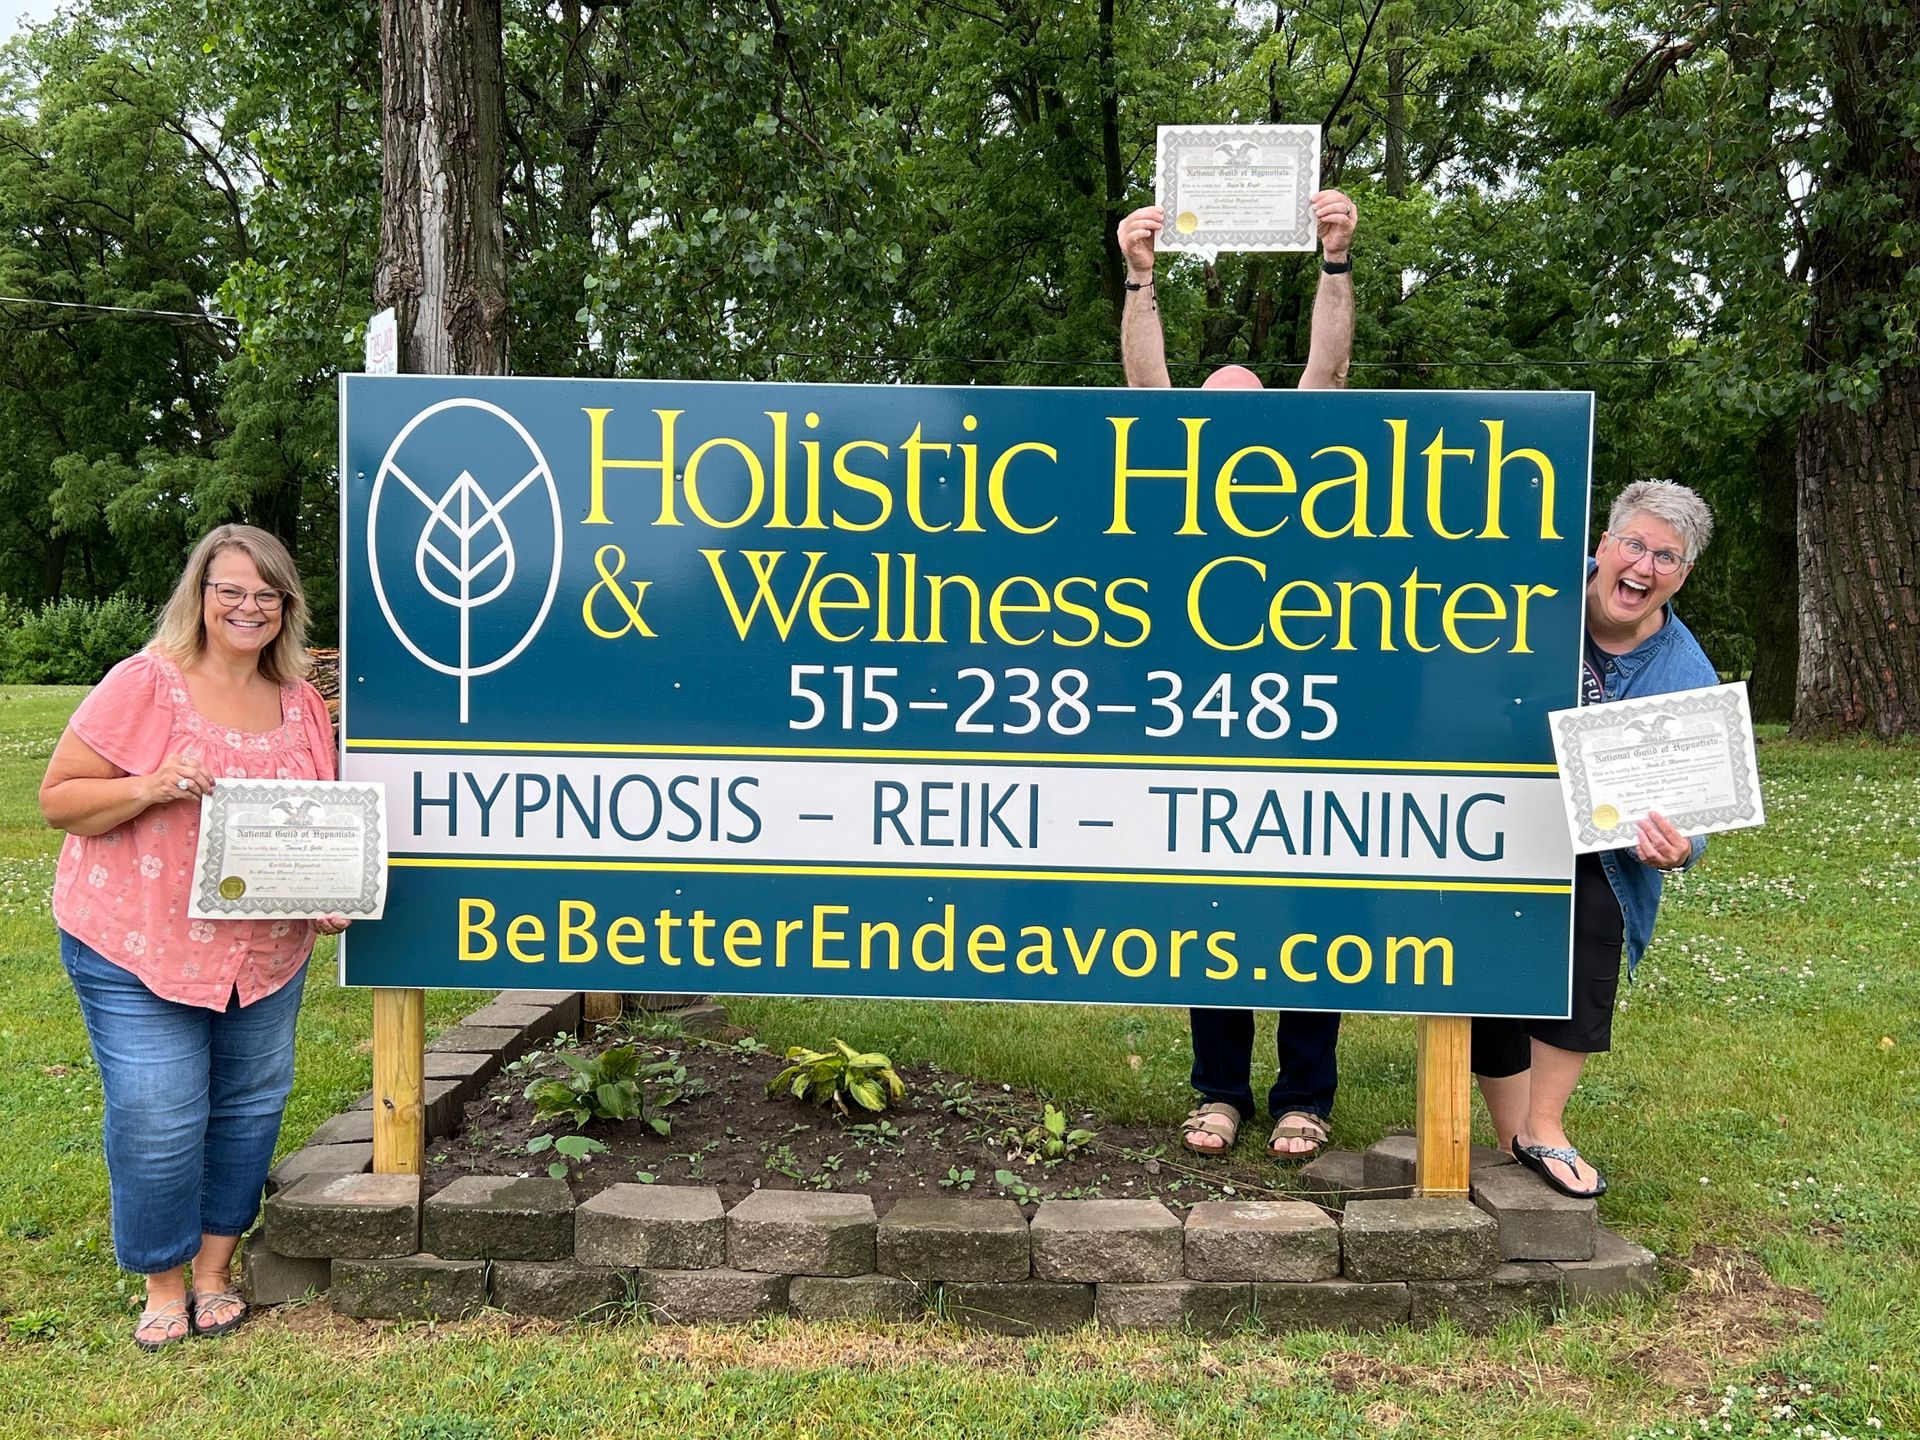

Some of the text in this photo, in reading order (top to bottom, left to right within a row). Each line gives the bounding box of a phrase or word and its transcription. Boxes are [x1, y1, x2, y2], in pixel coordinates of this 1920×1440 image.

[582, 408, 1560, 540] Holistic Health
[582, 547, 1558, 655] & Wellness Center
[788, 664, 1340, 742] 515-238-3485
[1594, 753, 1630, 764] National
[1633, 747, 1657, 758] Guild
[1673, 738, 1719, 753] Hypnotists
[237, 829, 356, 840] National Guild of Hypnotists
[412, 770, 763, 845] HYPNOSIS
[872, 779, 1040, 849] REIKI
[1147, 785, 1506, 863] TRAINING
[457, 897, 1455, 987] BeBetterEndeavors.com
